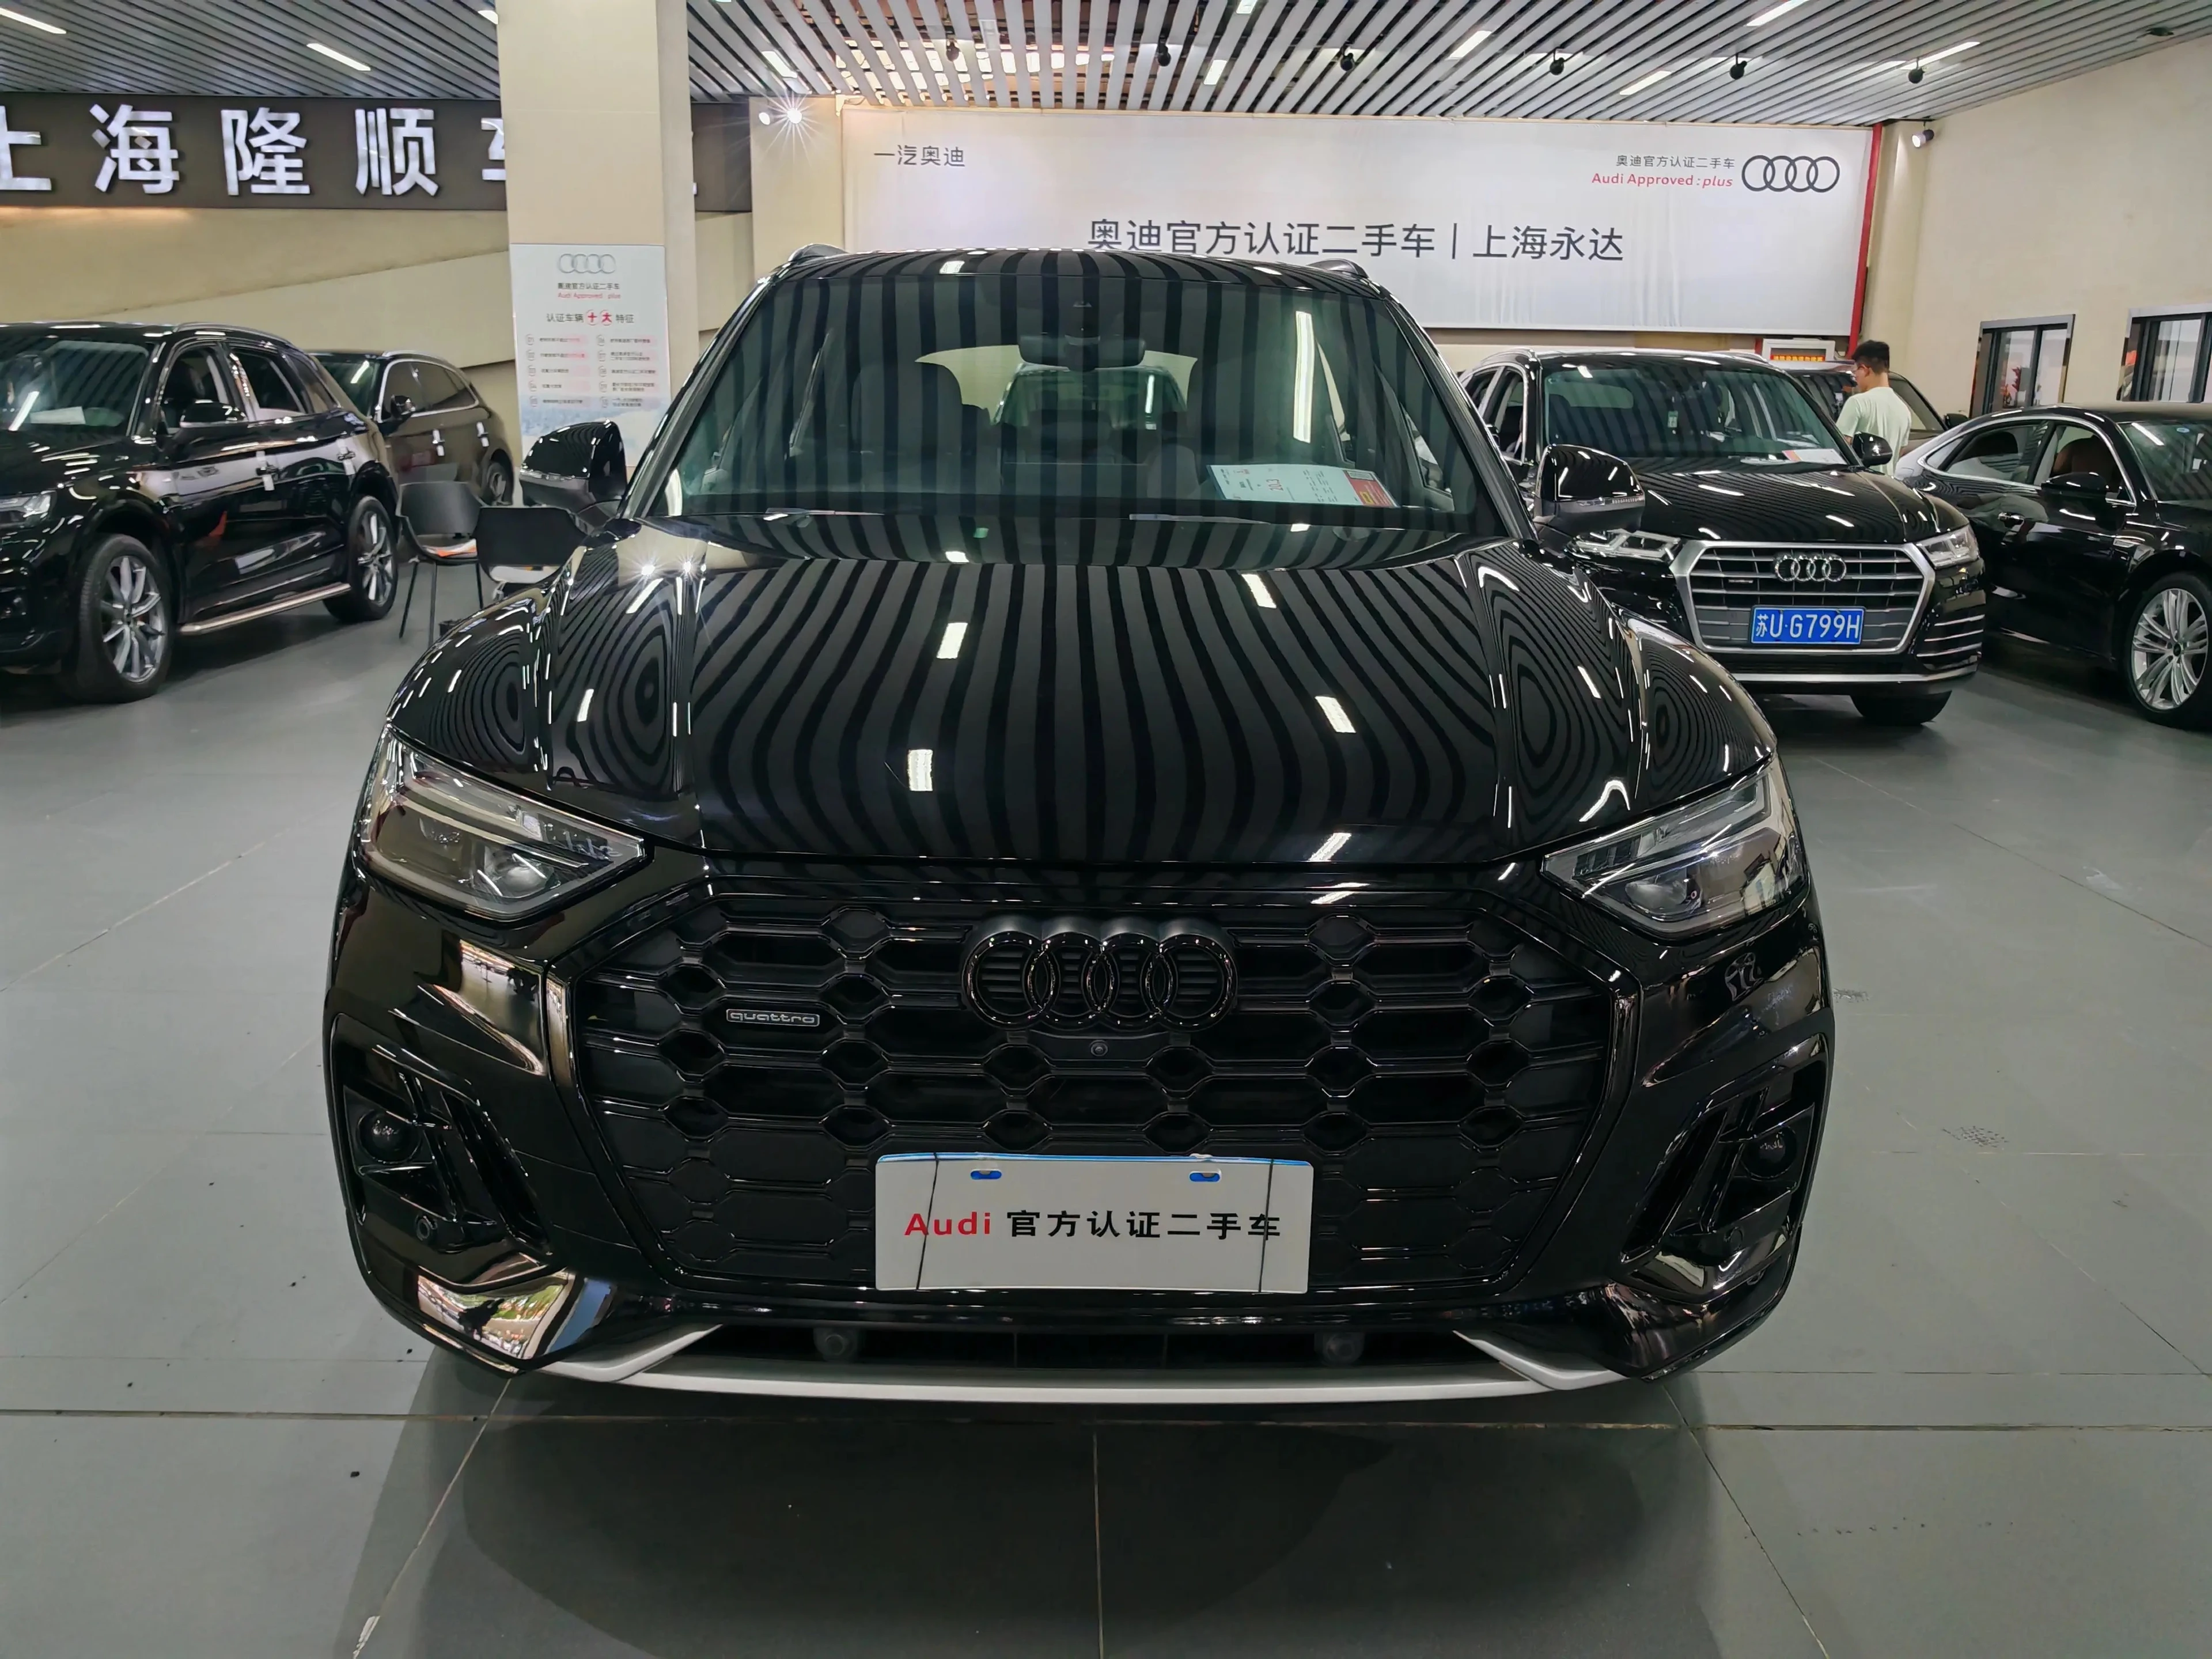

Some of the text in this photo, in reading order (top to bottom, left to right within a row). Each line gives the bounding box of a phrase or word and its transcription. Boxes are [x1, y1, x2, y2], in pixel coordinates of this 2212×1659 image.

[874, 145, 965, 167] 一汽奥迪
[1616, 155, 1735, 169] 奥迪官方认证二手车
[1592, 173, 1624, 184] Audi
[1627, 174, 1694, 187] Approved
[1088, 219, 1624, 261] 奥迪官方认证二手车 上海永达
[729, 1012, 816, 1024] quattro
[904, 1210, 1281, 1241] Audi 官方认证二手车
